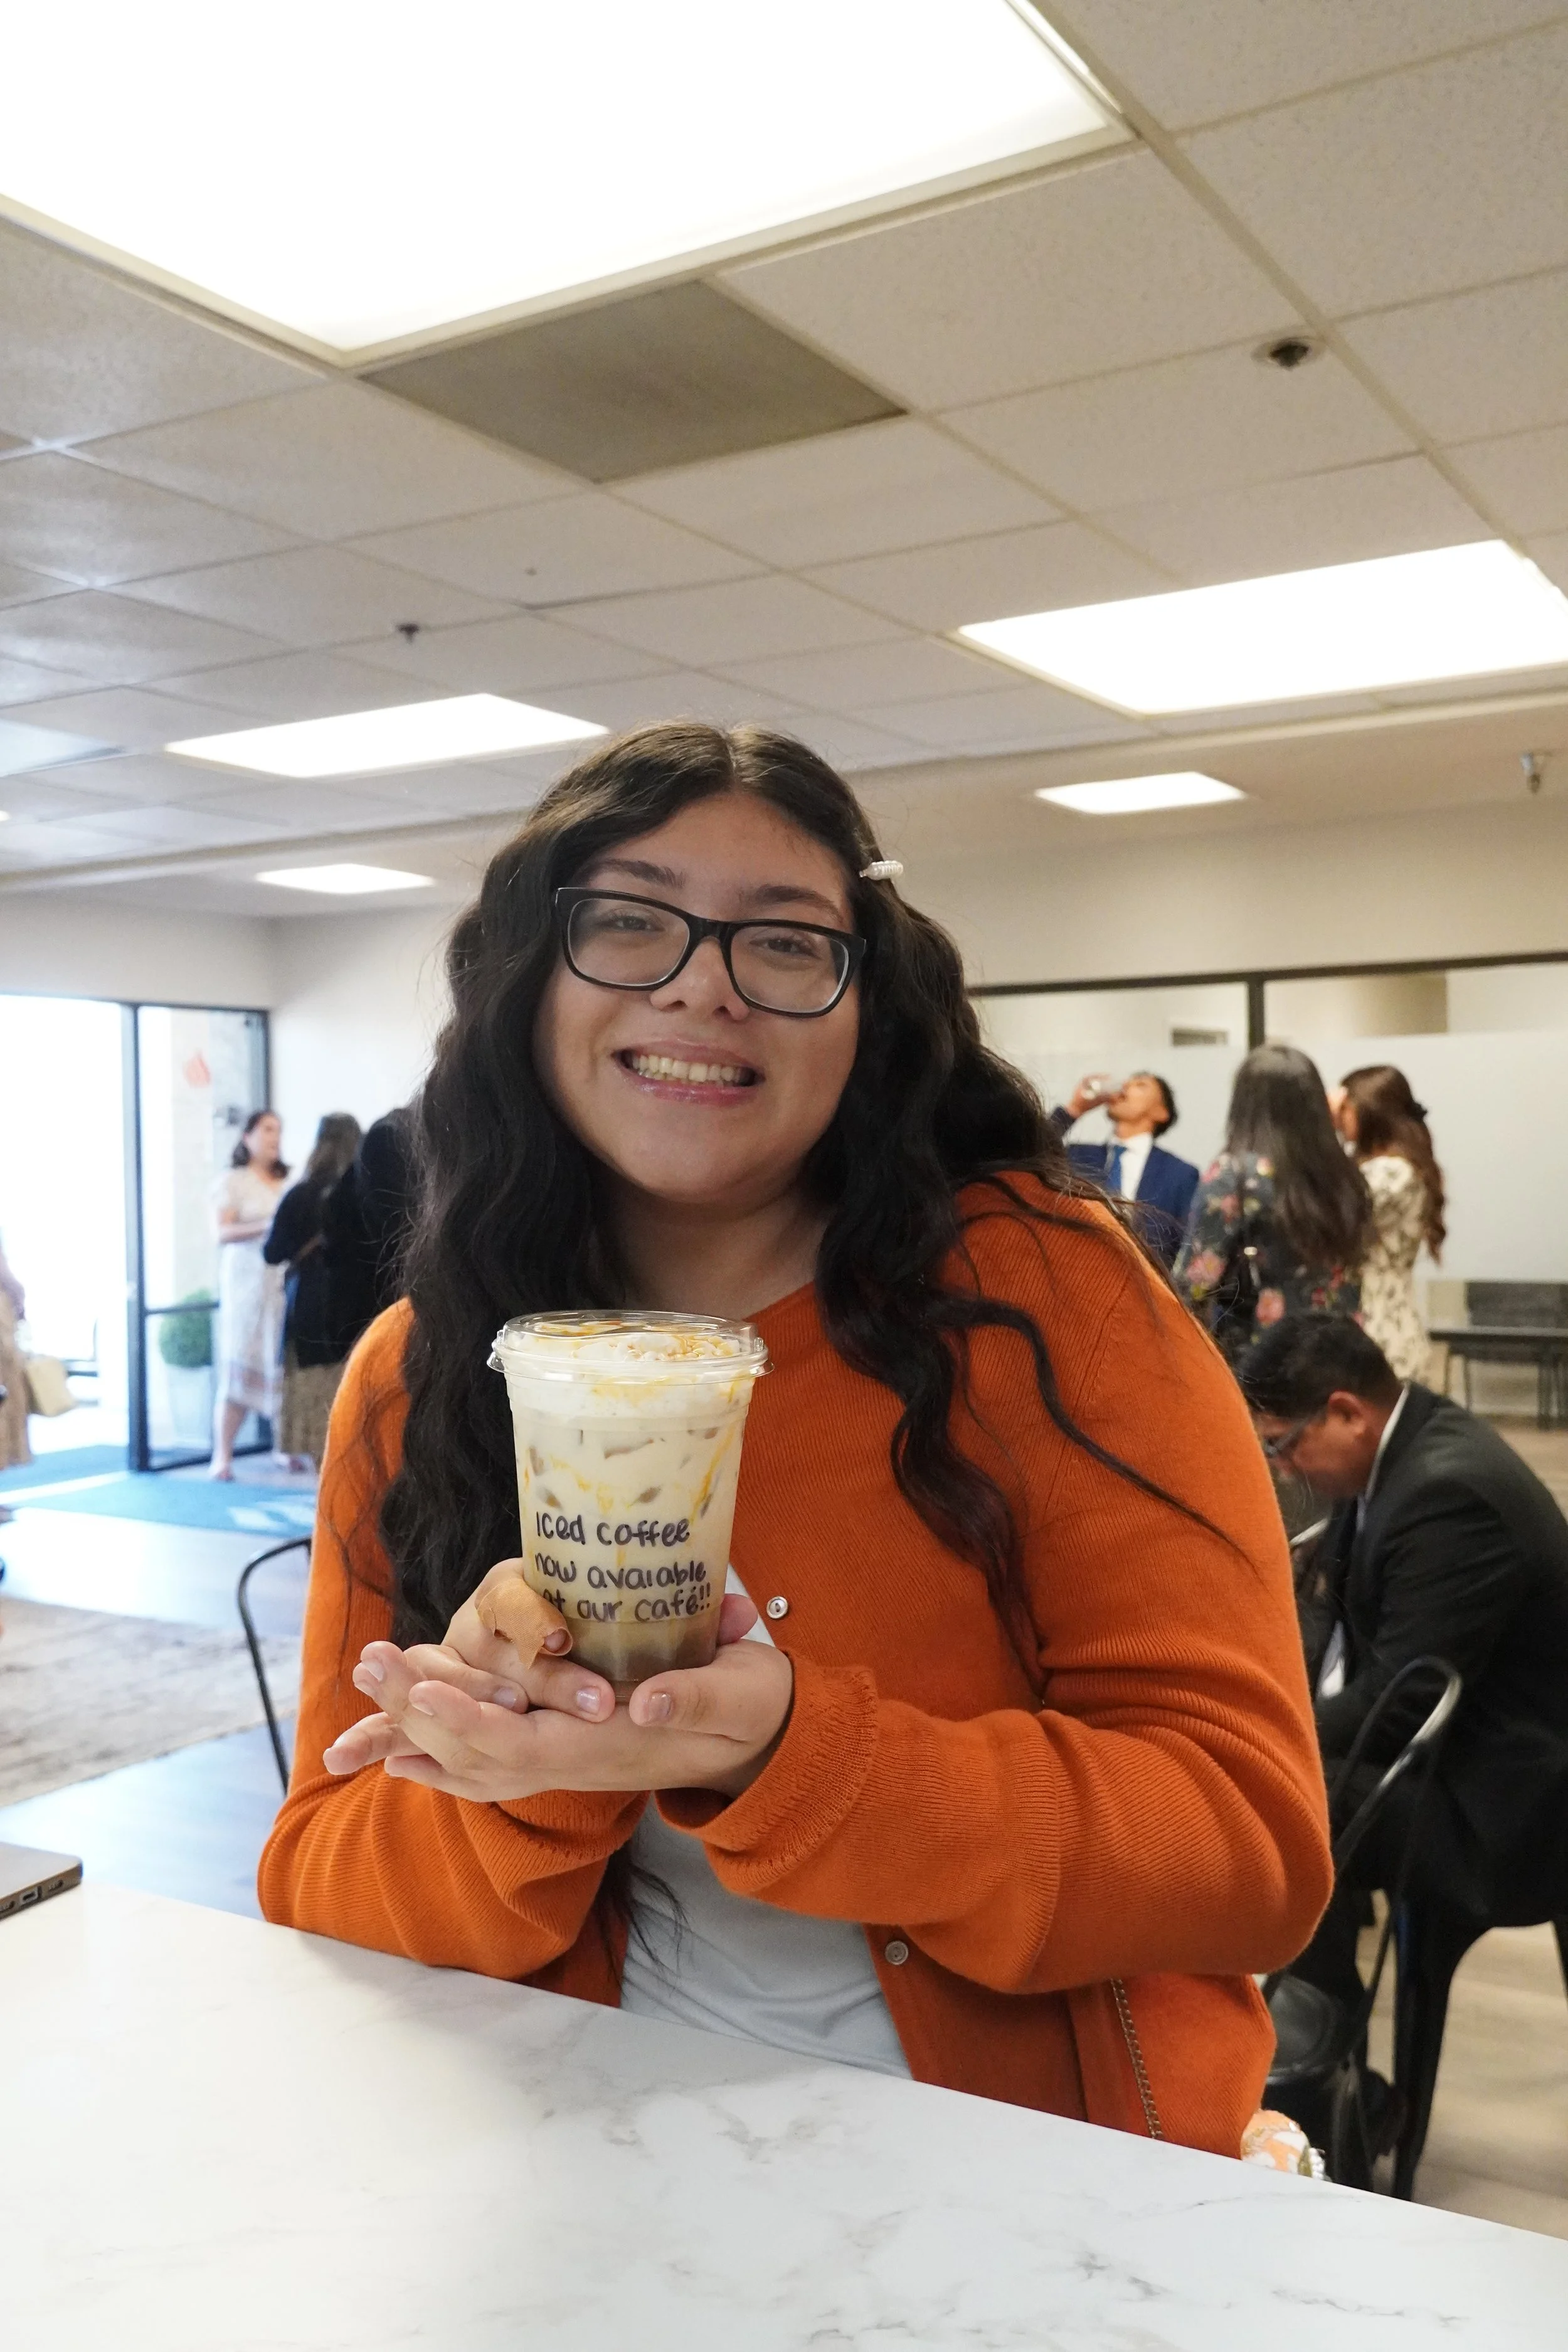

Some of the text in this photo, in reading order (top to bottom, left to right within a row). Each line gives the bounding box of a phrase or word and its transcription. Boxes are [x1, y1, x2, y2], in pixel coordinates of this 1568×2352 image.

[536, 1511, 690, 1547] Iced coffee
[534, 1552, 576, 1583] now
